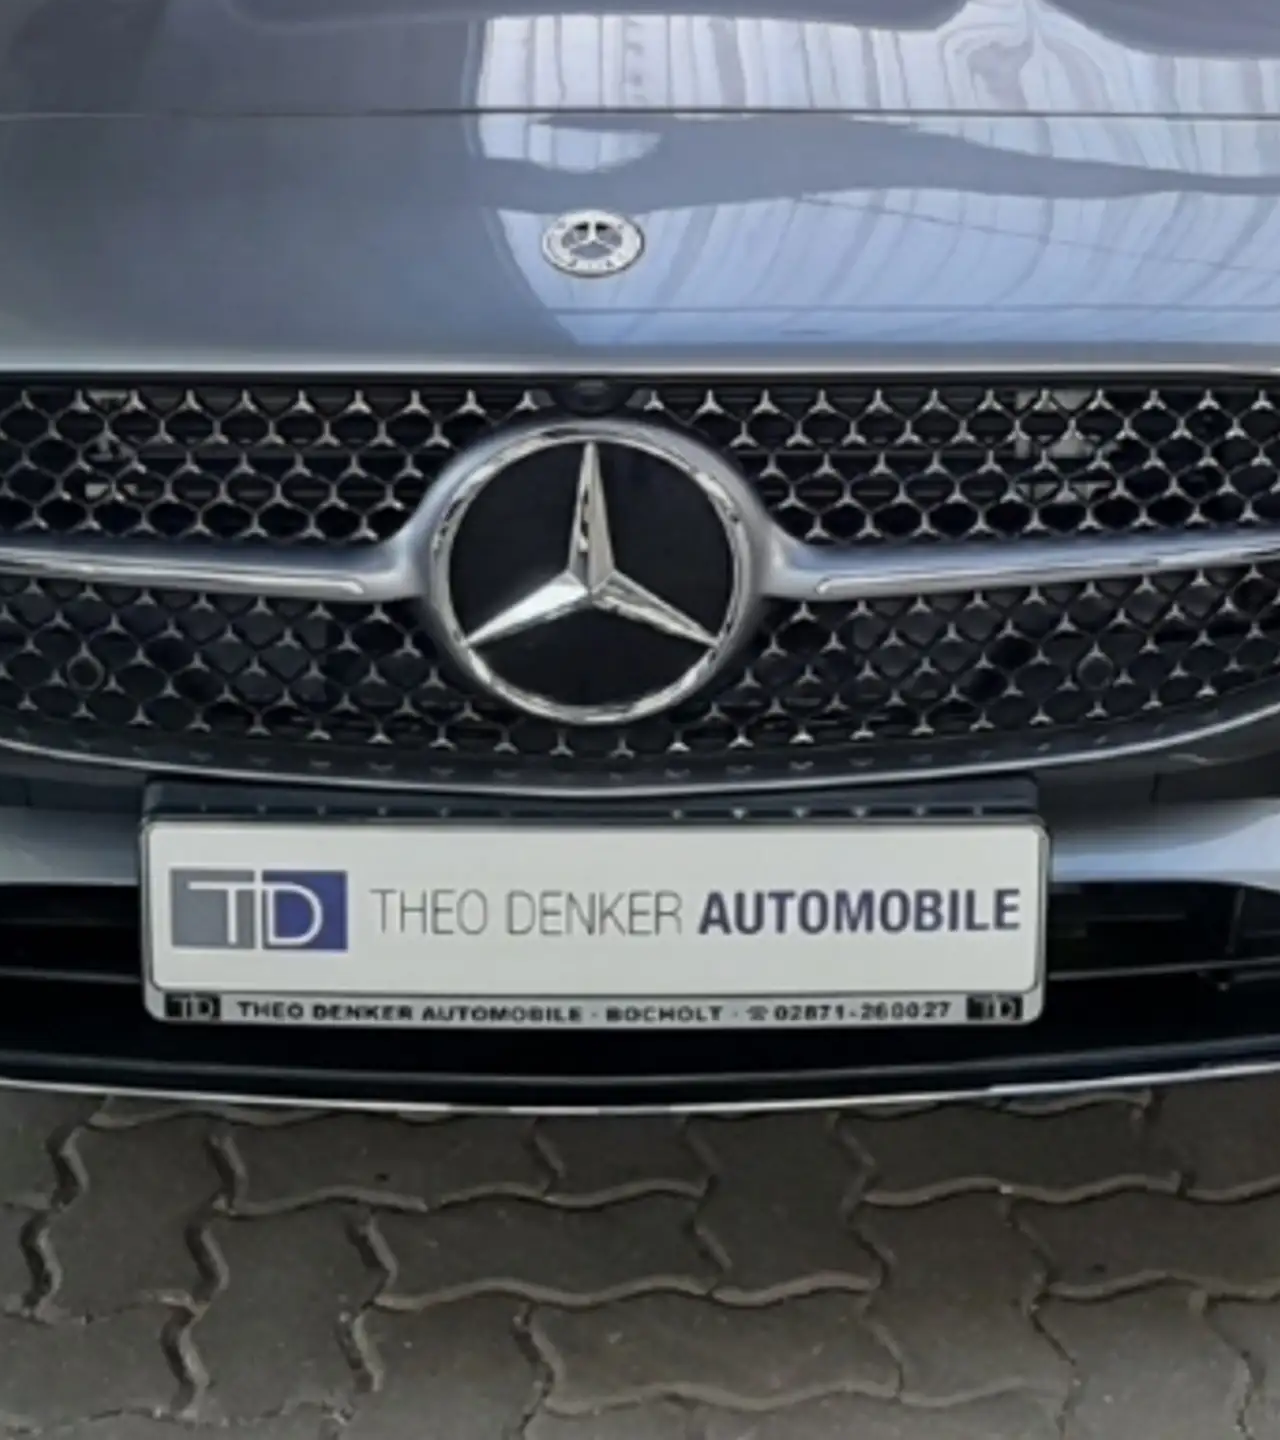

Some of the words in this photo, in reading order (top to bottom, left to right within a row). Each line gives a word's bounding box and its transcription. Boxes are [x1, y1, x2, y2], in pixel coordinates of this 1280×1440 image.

[188, 880, 323, 946] TD
[369, 887, 489, 935] THEO
[505, 888, 684, 936] DENKER
[696, 887, 1022, 936] AUTOMOBILE
[237, 1000, 305, 1020] THEO
[313, 1002, 414, 1022] DENKER
[421, 1003, 583, 1023] AUTOMOBILE
[606, 1004, 722, 1023] BOCHOLT
